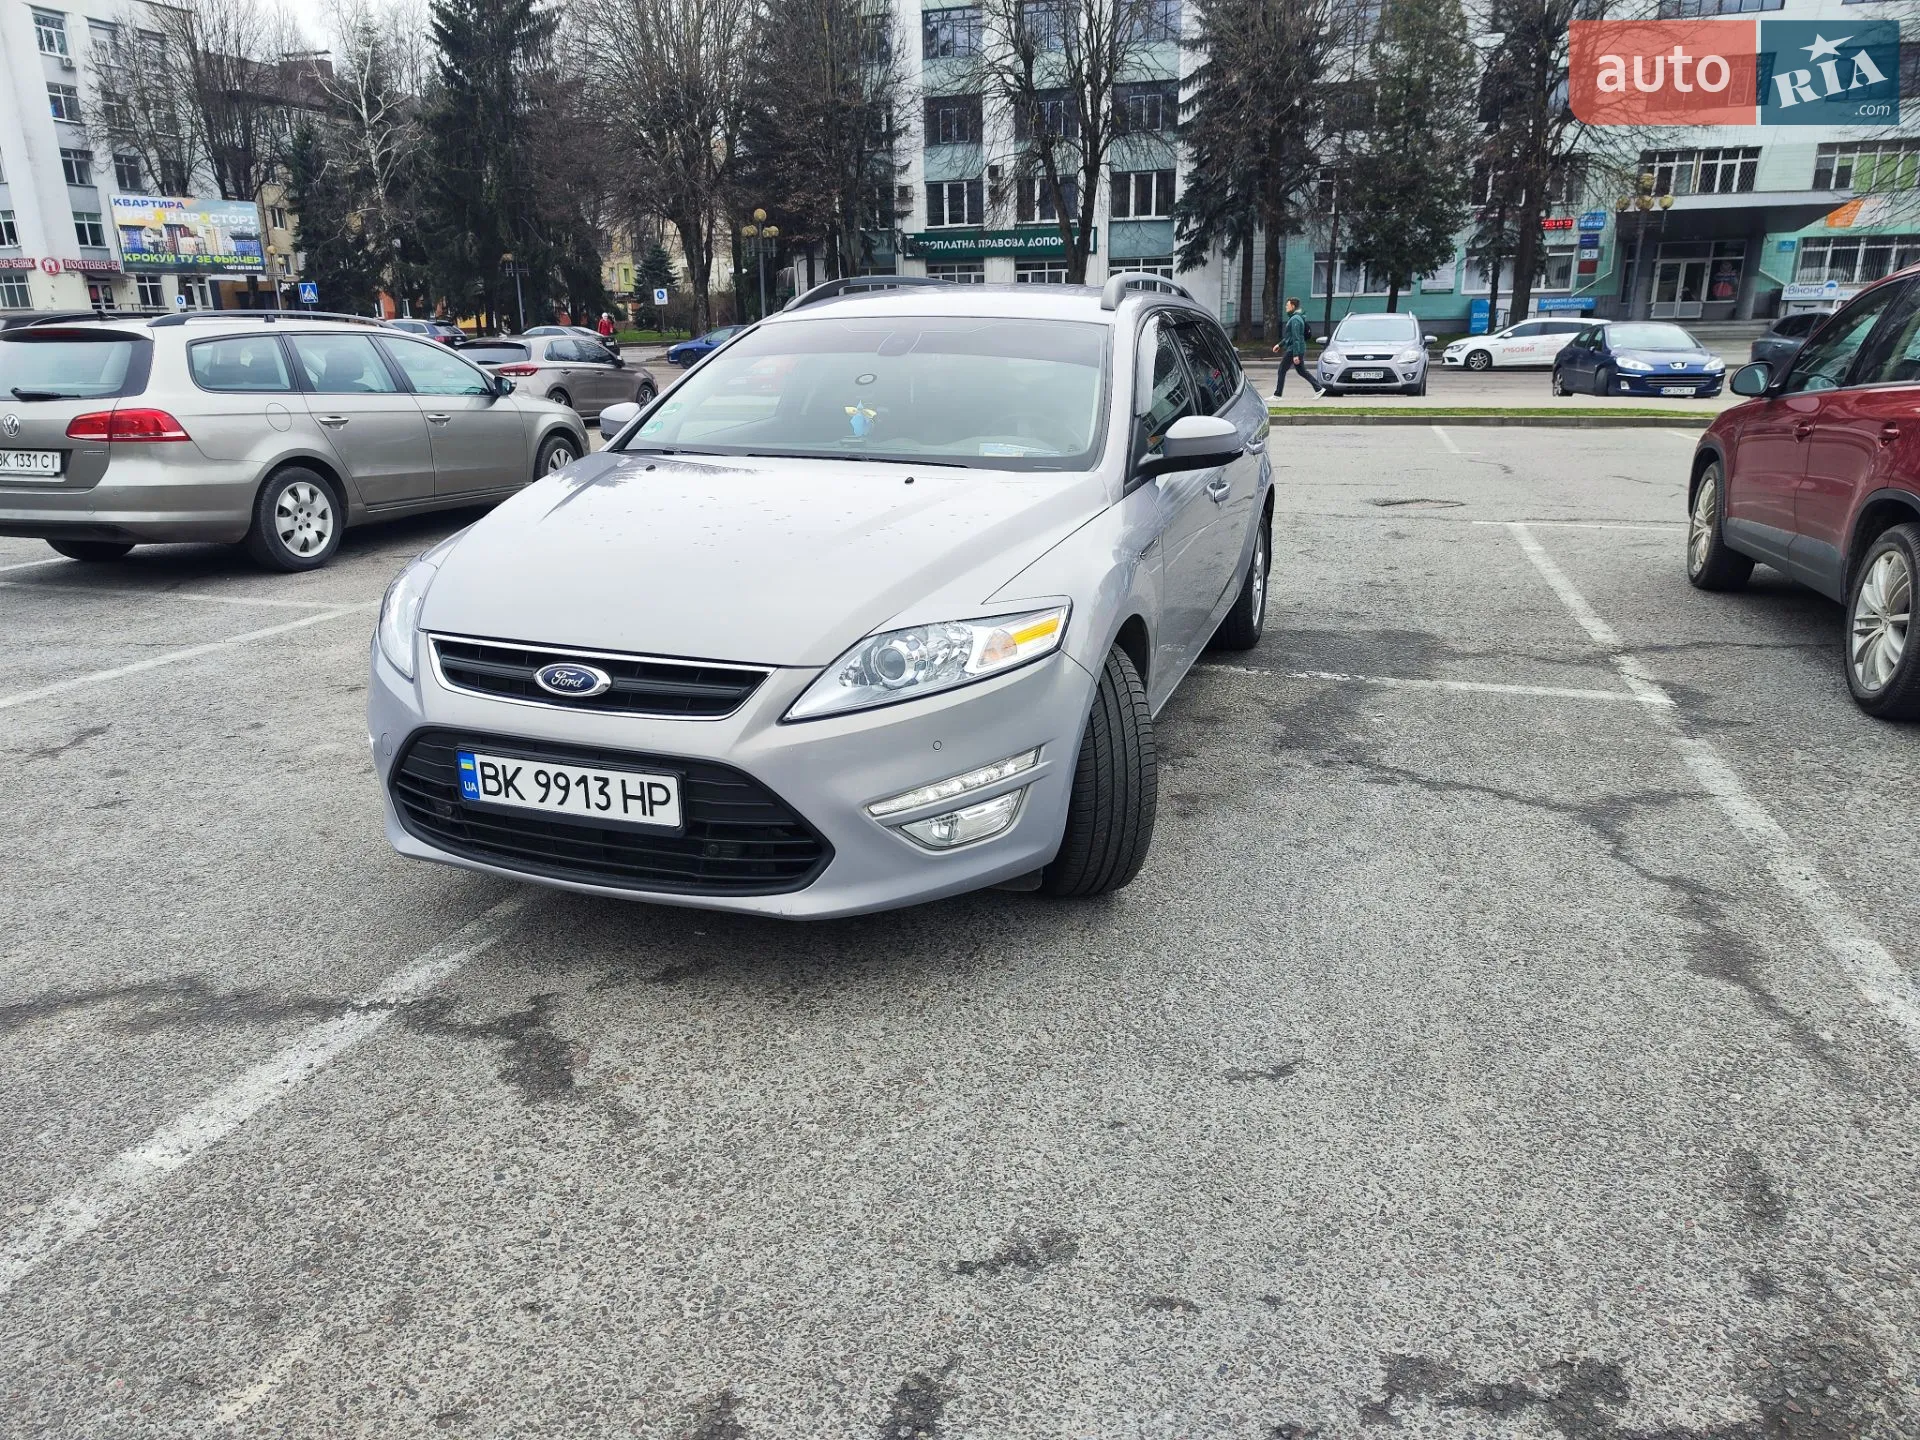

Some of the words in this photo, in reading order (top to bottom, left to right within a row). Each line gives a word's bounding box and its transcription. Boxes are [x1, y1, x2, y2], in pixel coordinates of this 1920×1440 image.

[113, 198, 185, 210] КВАРТИРА
[917, 239, 976, 251] ЕЗОПЛАТНА
[978, 237, 1025, 249] ПРАВОВА
[124, 252, 176, 265] КРОКУЙ
[178, 255, 193, 264] ТУ
[196, 255, 212, 264] ЗЕ
[1502, 346, 1535, 355] УЧБОВИЙ
[14, 452, 38, 469] 1331
[552, 670, 585, 689] Ford
[464, 780, 478, 794] UA
[479, 761, 526, 802] BK
[534, 769, 611, 812] 9913
[620, 779, 672, 818] HP
